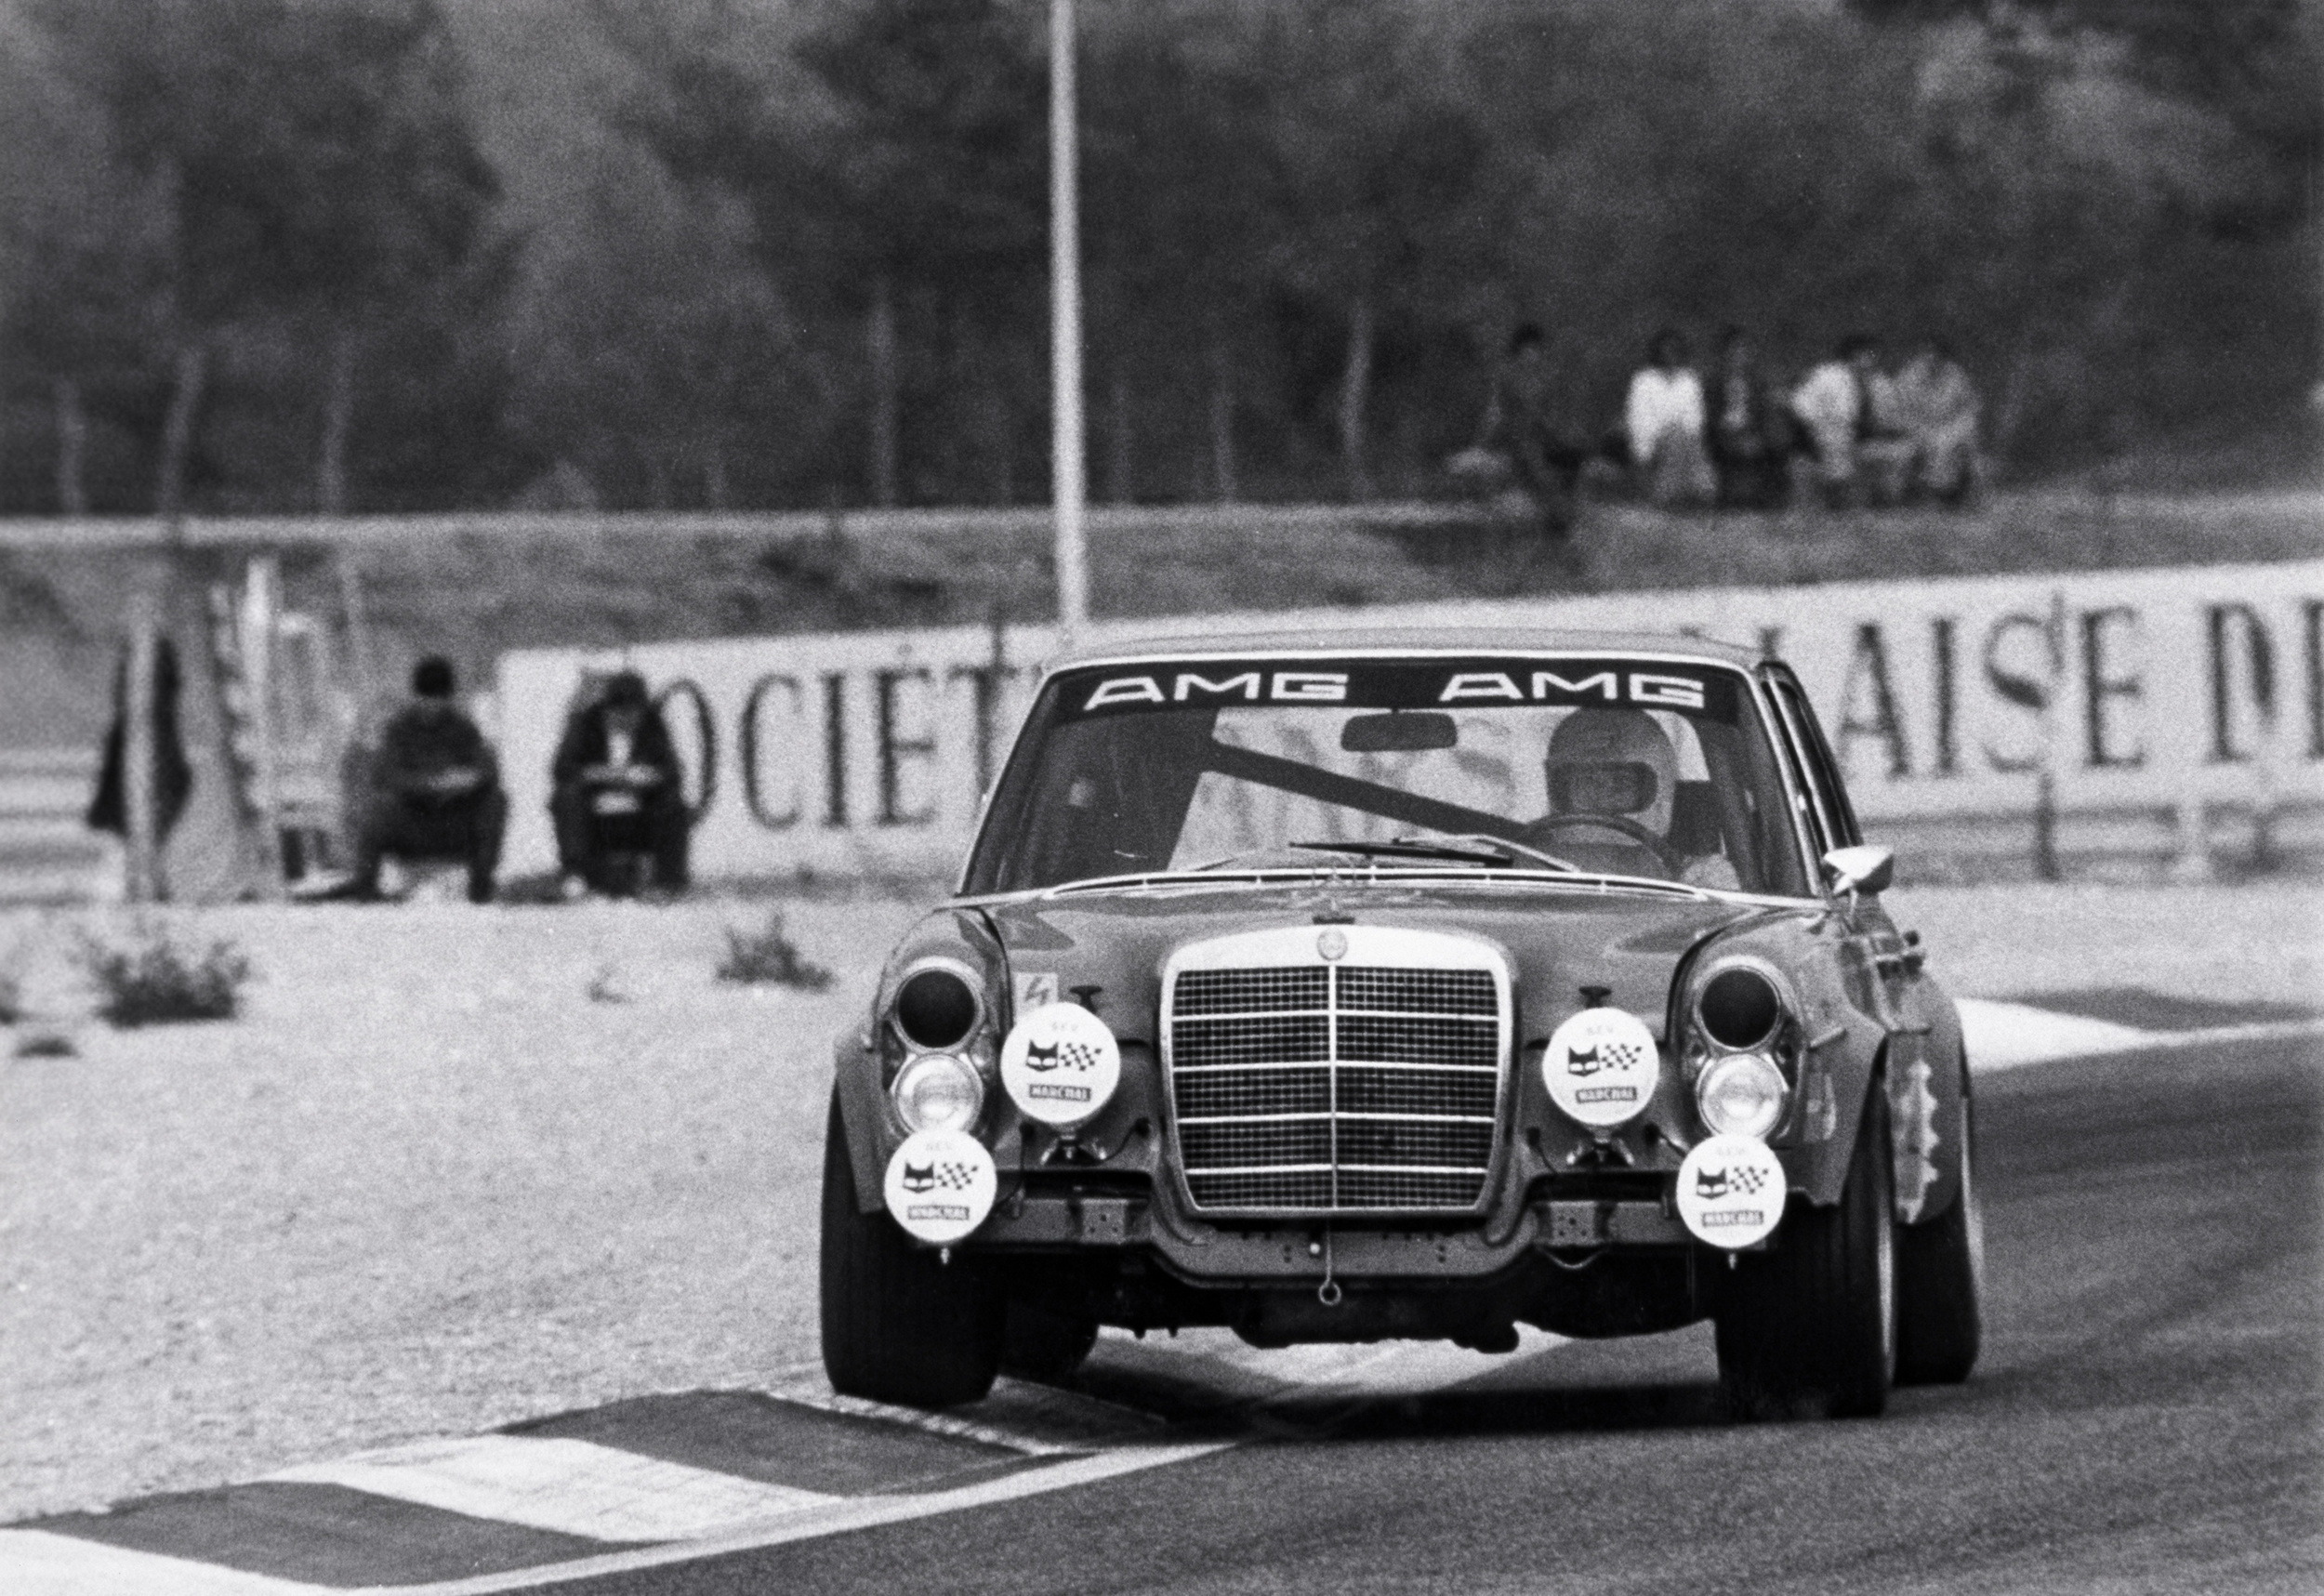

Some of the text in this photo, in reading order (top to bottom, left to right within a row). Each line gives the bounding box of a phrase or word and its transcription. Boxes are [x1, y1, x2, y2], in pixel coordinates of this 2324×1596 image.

[1083, 671, 1704, 710] AMG AMG
[1757, 602, 2141, 779] AISE
